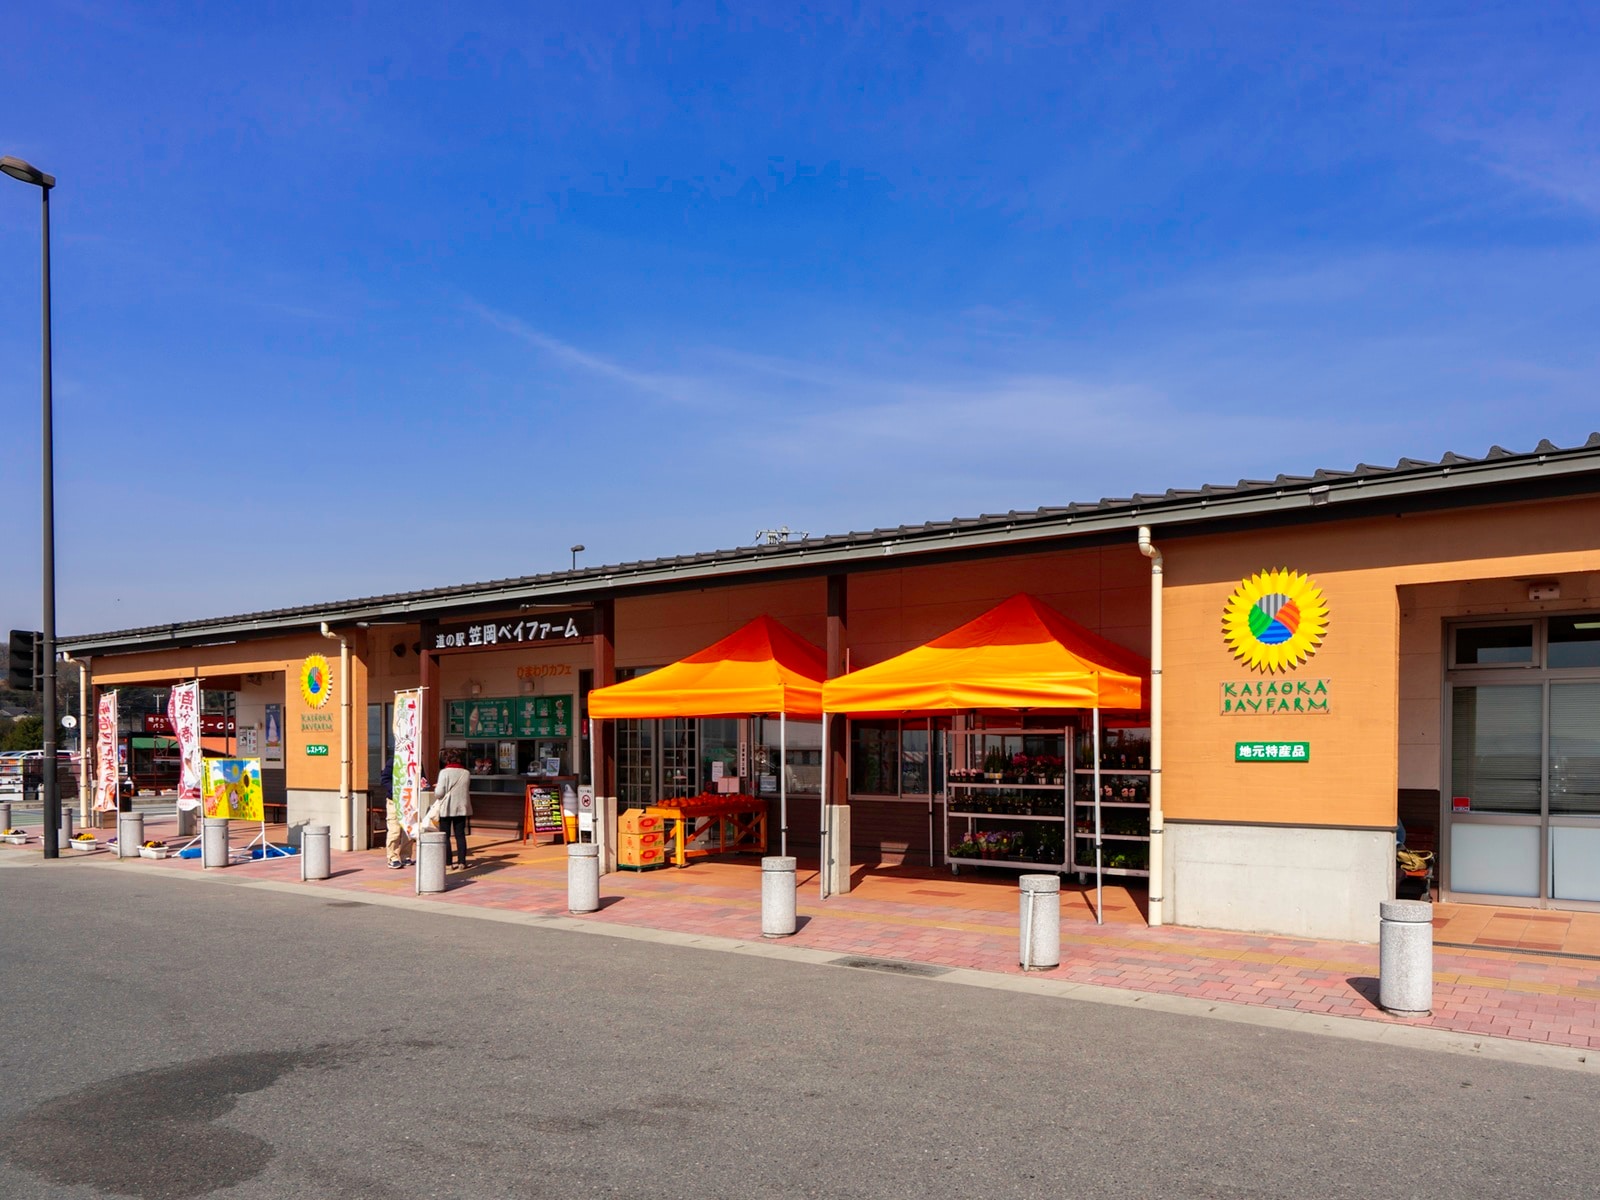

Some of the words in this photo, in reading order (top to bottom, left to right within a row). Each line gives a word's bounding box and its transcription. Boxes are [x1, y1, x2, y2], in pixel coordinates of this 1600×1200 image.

[435, 632, 466, 648] 道の駅
[468, 617, 579, 646] 笠岡ベイファーム
[516, 664, 572, 678] ひまわりカフェ
[1224, 680, 1328, 697] KASAOKA
[1224, 697, 1328, 712] BAYFARM
[306, 746, 328, 754] レストラン
[1239, 745, 1305, 757] 地元特産品
